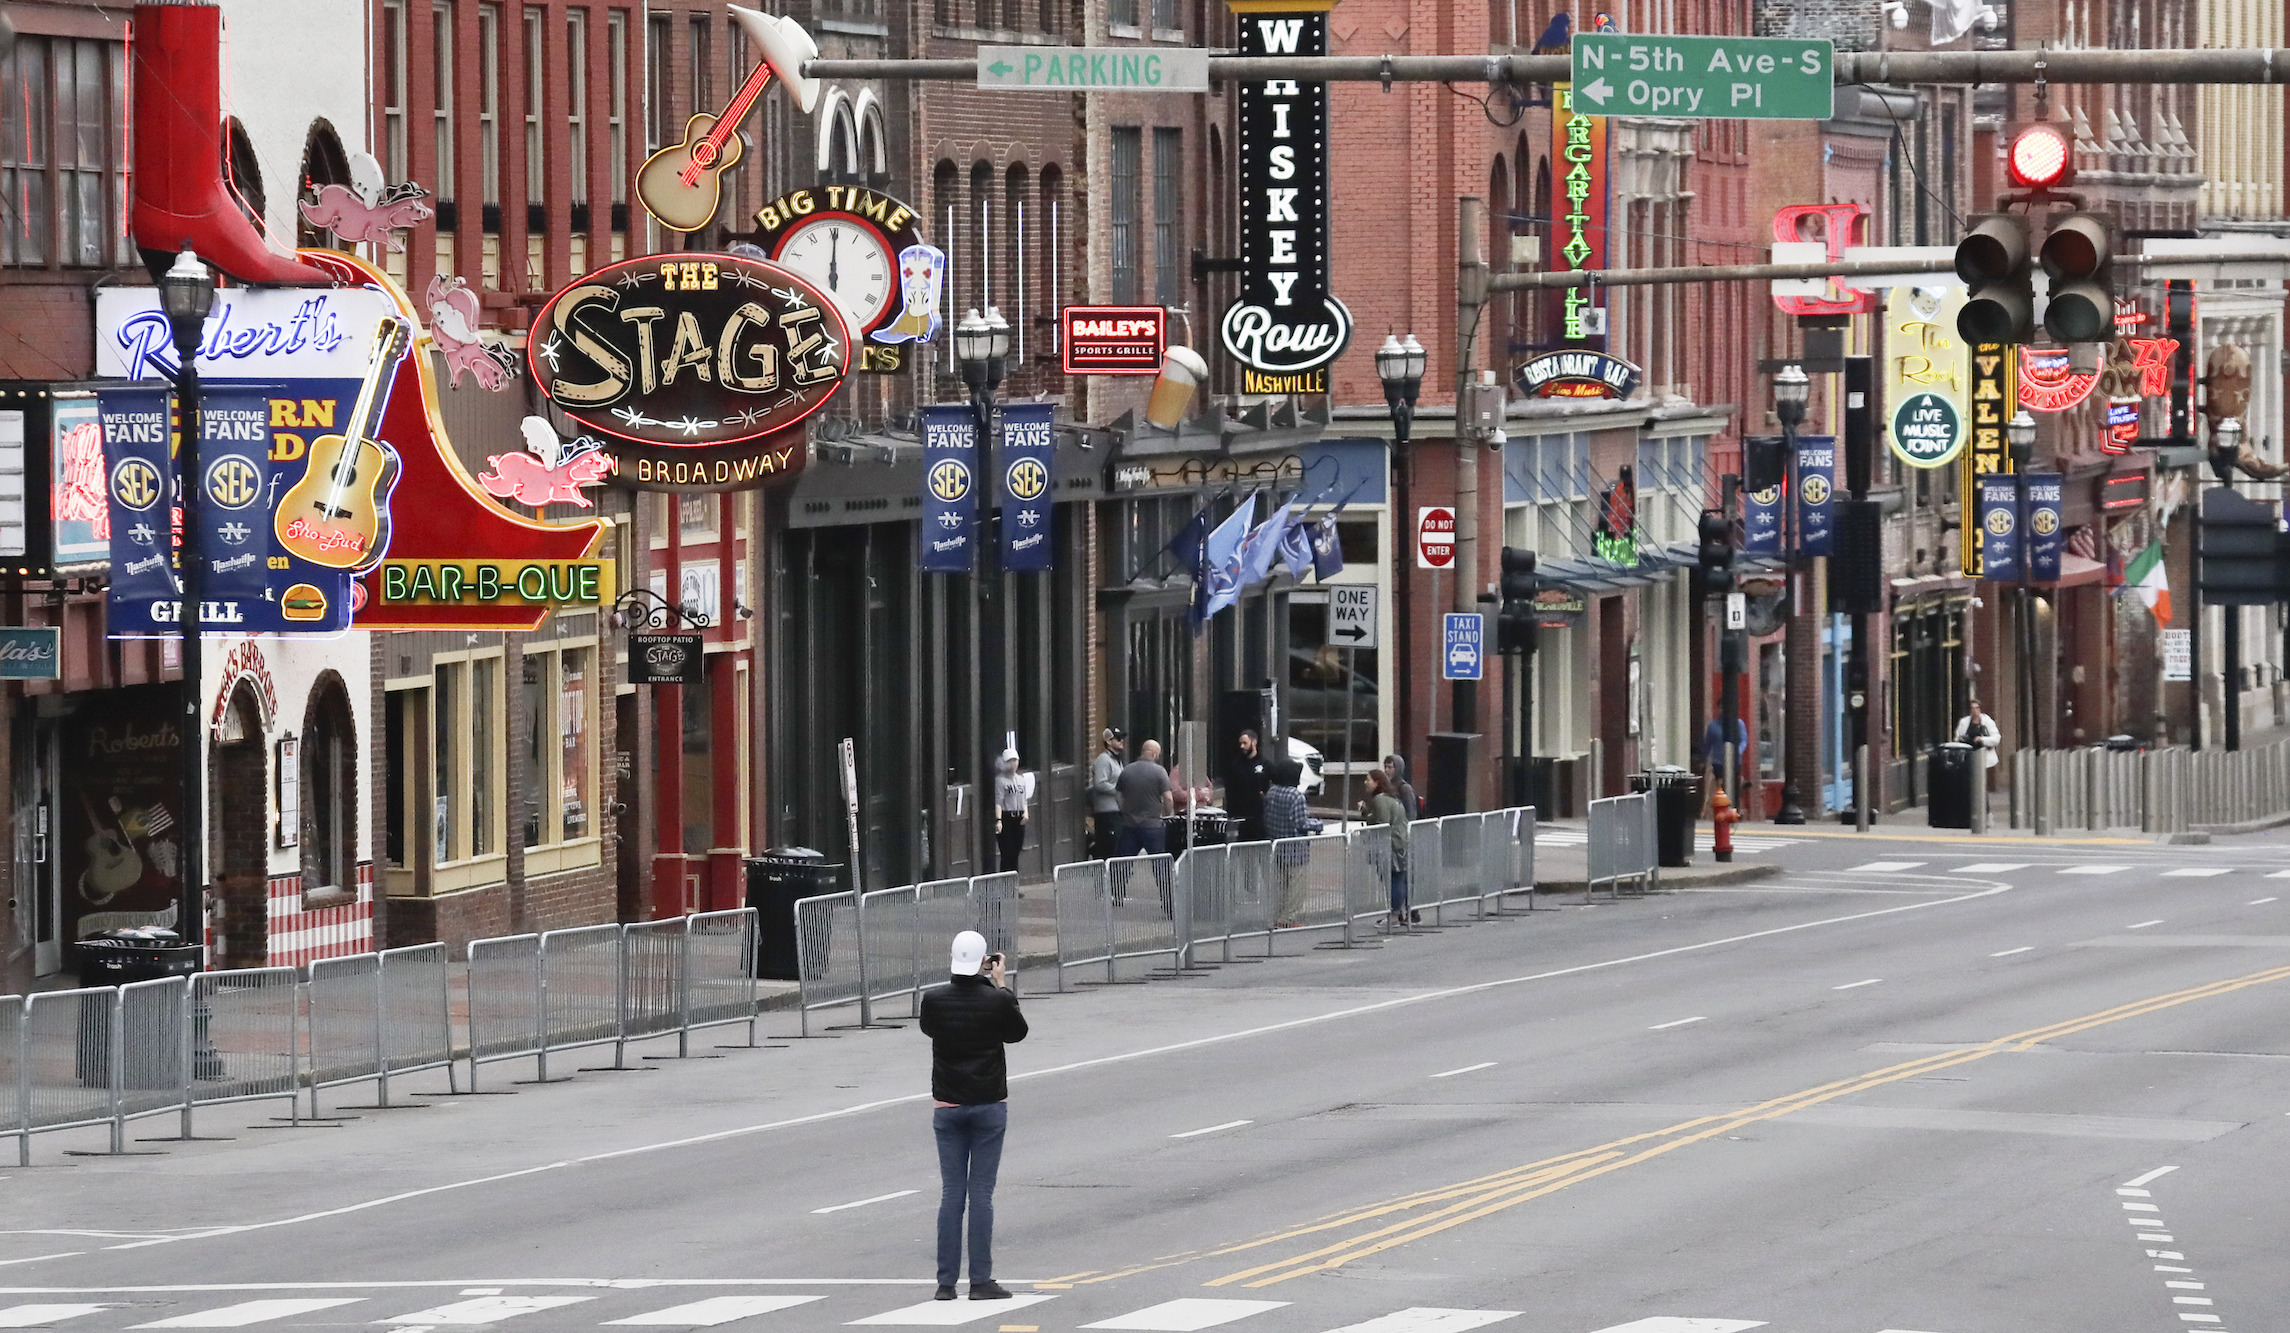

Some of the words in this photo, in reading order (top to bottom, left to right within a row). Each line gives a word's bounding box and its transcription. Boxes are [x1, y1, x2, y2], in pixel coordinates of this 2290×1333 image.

[1024, 54, 1162, 86] PARKING
[1627, 79, 1704, 112] Opry
[1731, 83, 1762, 108] Pl
[757, 190, 816, 232] BIG
[825, 185, 911, 232] TIME
[1562, 91, 1593, 340] ARGARITAVLLE
[661, 262, 719, 291] THE
[117, 295, 345, 381] Rbert's
[1072, 320, 1157, 337] BAILEY'S
[1232, 305, 1335, 370] Row
[1900, 321, 1952, 351] Tin
[552, 285, 838, 406] STAGE
[1074, 347, 1113, 355] SPORTS
[1116, 347, 1155, 355] GRILLE
[2104, 338, 2180, 369] RAZY
[1524, 354, 1599, 385] RESTAURANT
[1604, 361, 1629, 387] BAR
[1895, 355, 1961, 392] Roof
[1245, 368, 1325, 394] NASHVILLE
[1575, 384, 1605, 396] Music
[2046, 374, 2094, 407] KITCHE
[2100, 366, 2168, 397] OWN
[1921, 395, 1933, 407] A
[102, 412, 163, 424] WELCOME
[203, 410, 265, 422] WELCOME
[1912, 409, 1943, 423] LIVE
[2110, 406, 2130, 416] LIVE
[2110, 414, 2138, 424] MUSIC
[105, 424, 163, 443] FANS
[204, 422, 265, 441] FANS
[927, 424, 973, 432] WELCOME
[1004, 422, 1050, 431] WELCOME
[1903, 424, 1951, 438] MUSIC
[927, 433, 974, 448] FANS
[1005, 431, 1050, 447] FANS
[1906, 439, 1949, 453] JOINT
[639, 447, 793, 483] BROADWAY
[1799, 456, 1833, 467] FANS
[117, 463, 156, 505] SEC
[212, 461, 256, 504] SEC
[933, 463, 966, 498] SEC
[1012, 462, 1043, 496] SEC
[1804, 481, 1828, 504] SEC
[1984, 491, 2016, 502] FANS
[2030, 491, 2060, 501] FANS
[1426, 520, 1436, 529] DO
[1438, 520, 1454, 529] NOT
[286, 521, 366, 552] Sho-Bud
[1427, 546, 1450, 555] ENTER
[212, 553, 256, 574] Nashville
[385, 564, 600, 601] BAR-B-QUE
[1337, 590, 1369, 604] ONE
[1336, 607, 1369, 621] WAY
[1453, 618, 1475, 629] TAXI
[1447, 632, 1479, 643] STAND
[0, 638, 51, 658] la's
[646, 647, 686, 664] STAGE
